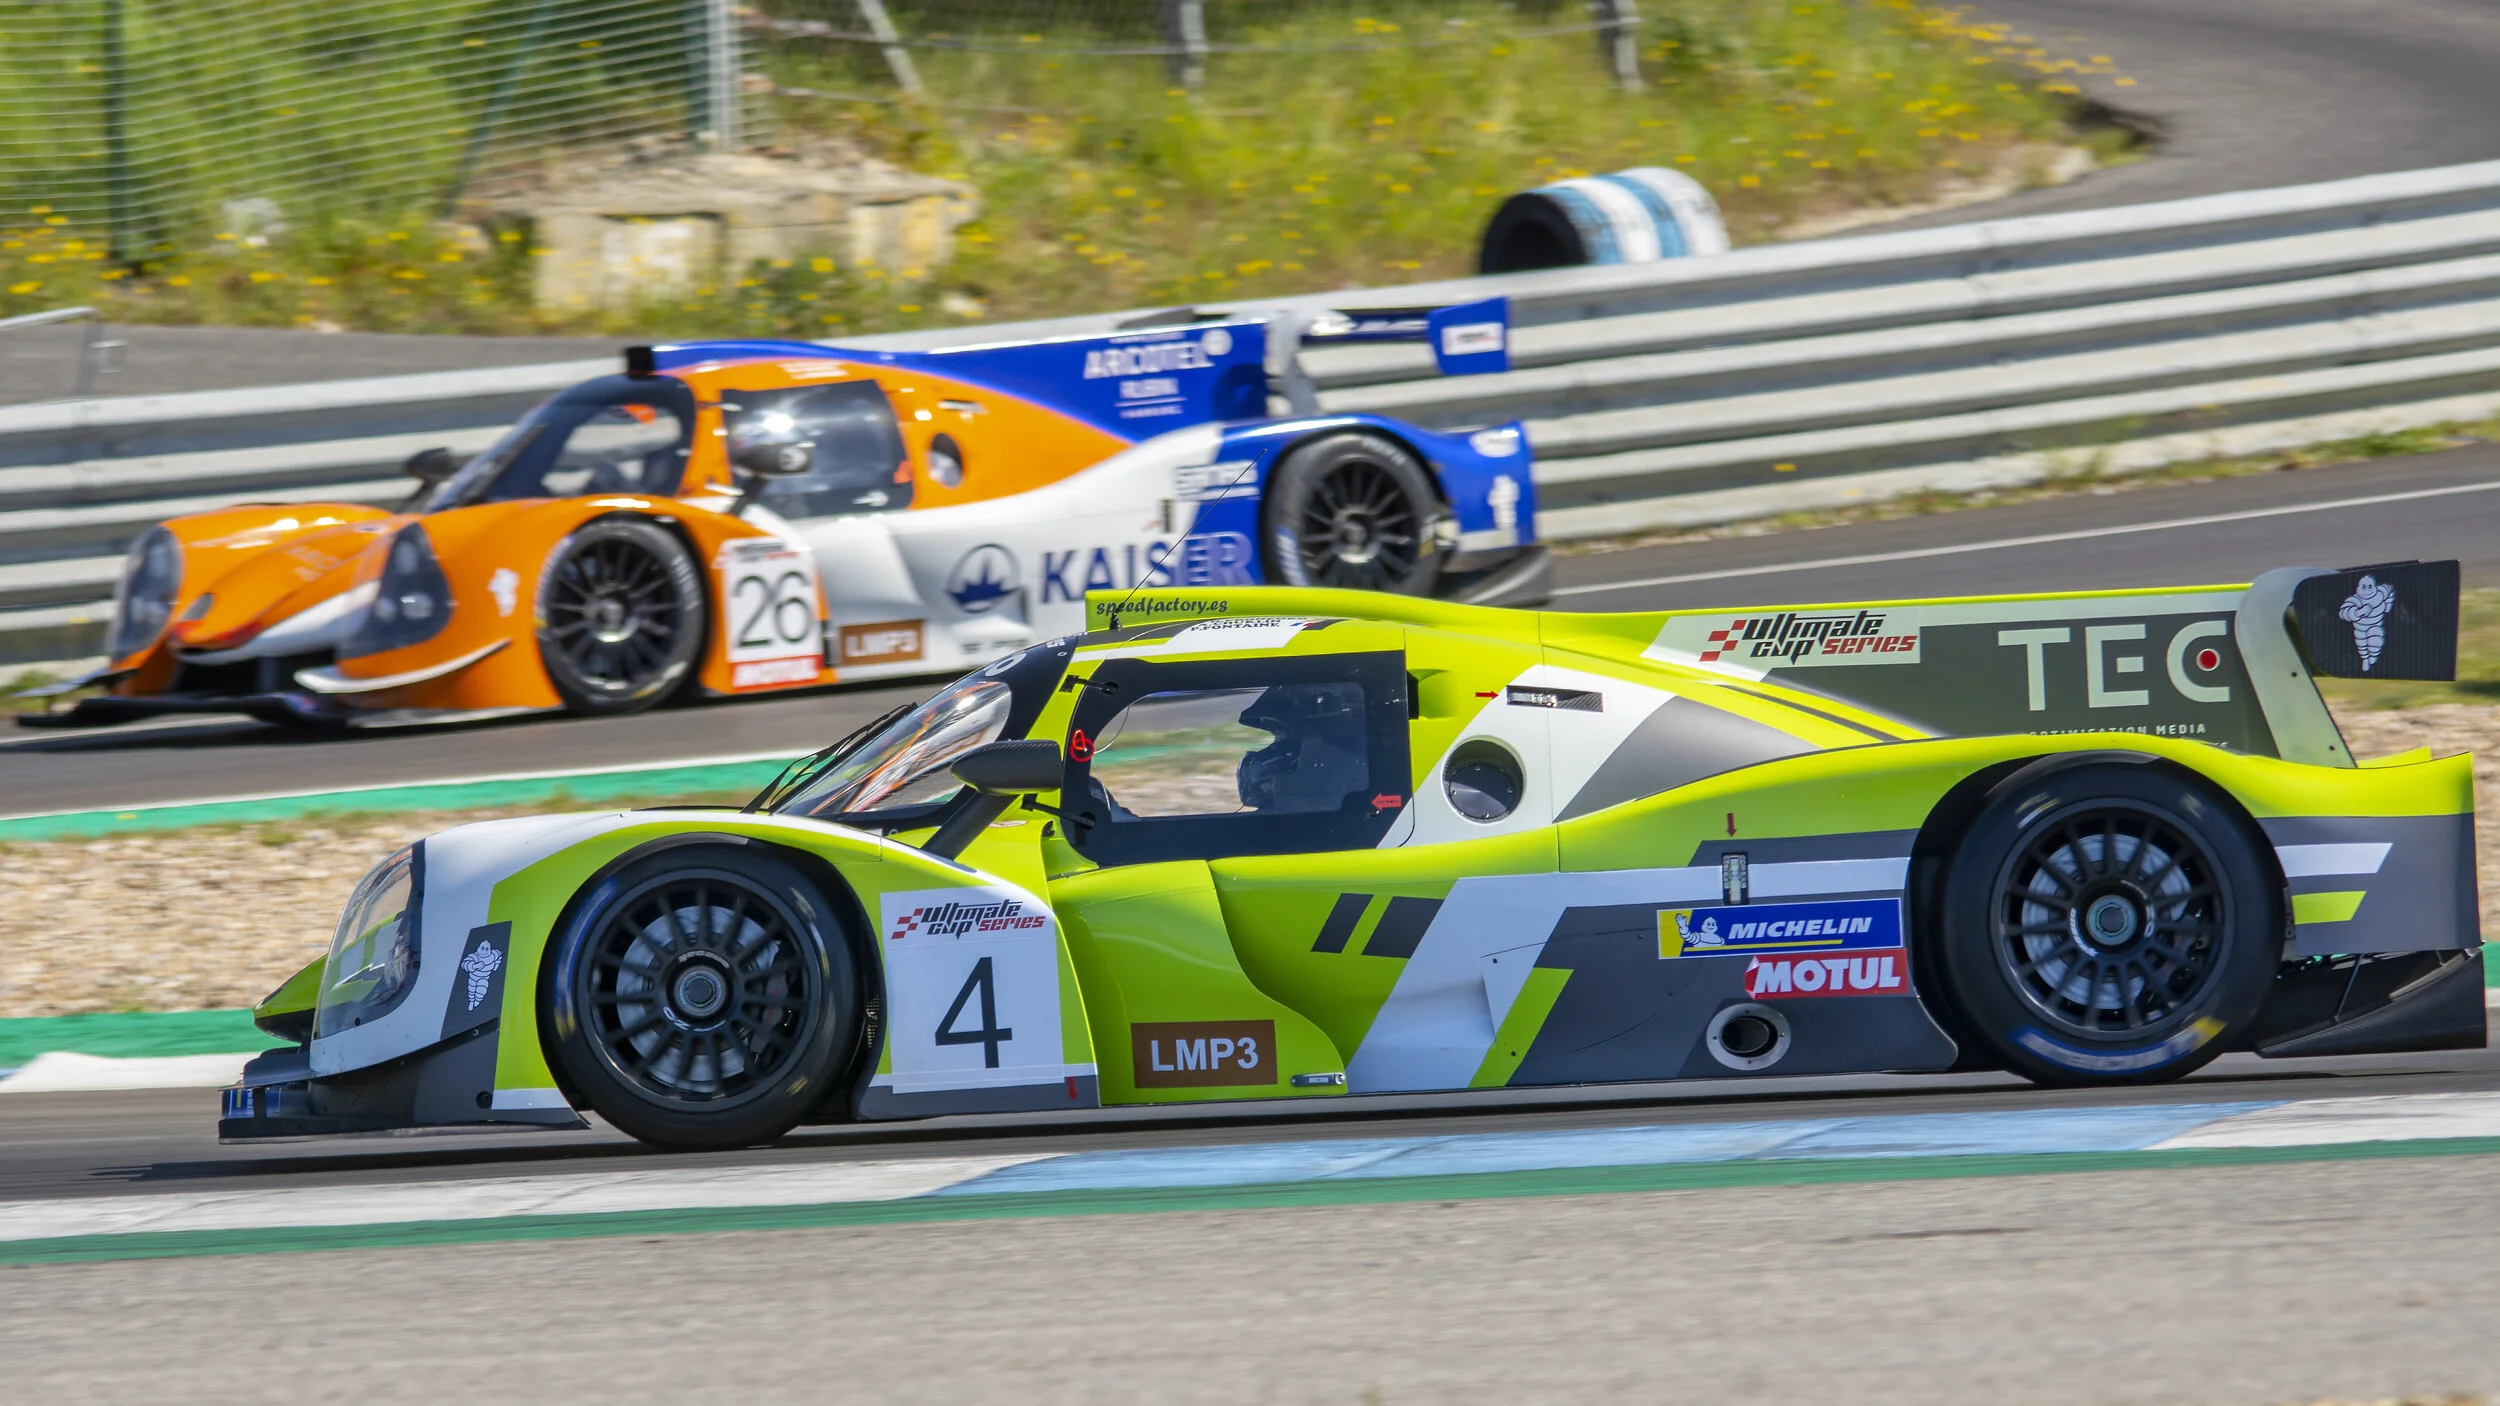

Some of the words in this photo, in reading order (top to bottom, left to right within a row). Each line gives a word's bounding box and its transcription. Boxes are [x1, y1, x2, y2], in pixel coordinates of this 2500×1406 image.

[1041, 531, 1255, 603] KAISER
[733, 570, 812, 647] 26
[1096, 596, 1228, 616] speedfactory.es
[1821, 635, 1918, 655] series
[1998, 620, 2230, 711] TEC
[2156, 723, 2207, 735] MEDIA
[978, 915, 1046, 931] series
[1728, 917, 1872, 940] MICHELIN
[1753, 956, 1901, 993] MOTUL
[934, 956, 1012, 1069] 4
[1151, 1037, 1259, 1072] LMP3
